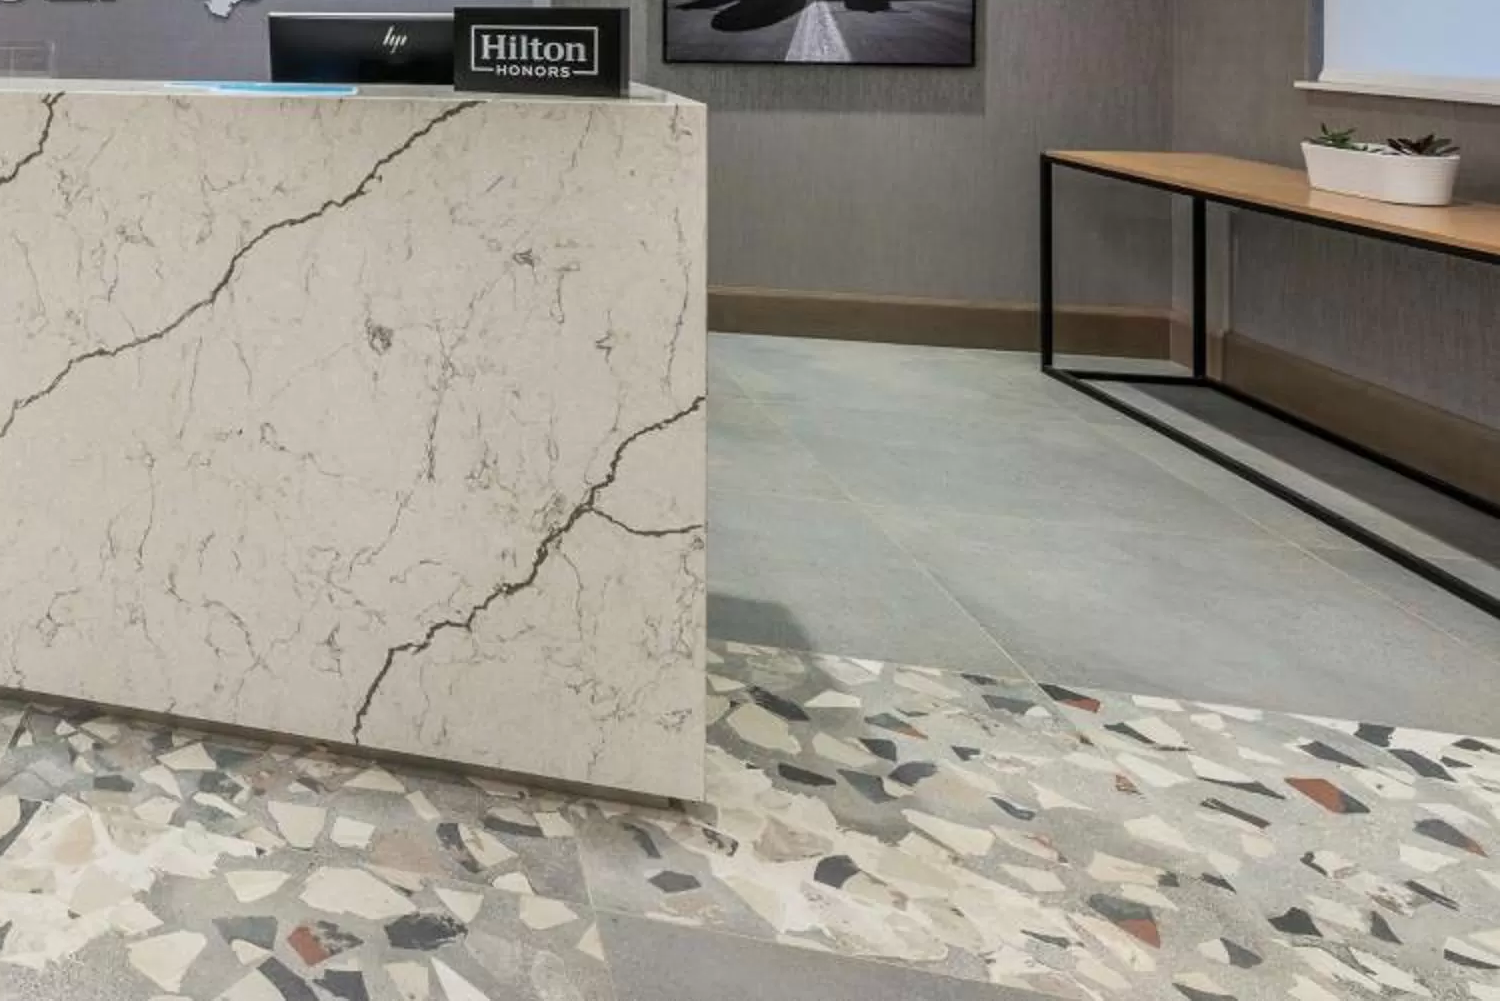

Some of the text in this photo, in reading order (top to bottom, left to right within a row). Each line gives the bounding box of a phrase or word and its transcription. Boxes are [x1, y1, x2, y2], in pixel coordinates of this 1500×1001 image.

[382, 25, 409, 55] hp
[481, 34, 587, 62] Hilton
[496, 64, 571, 78] HONORS
